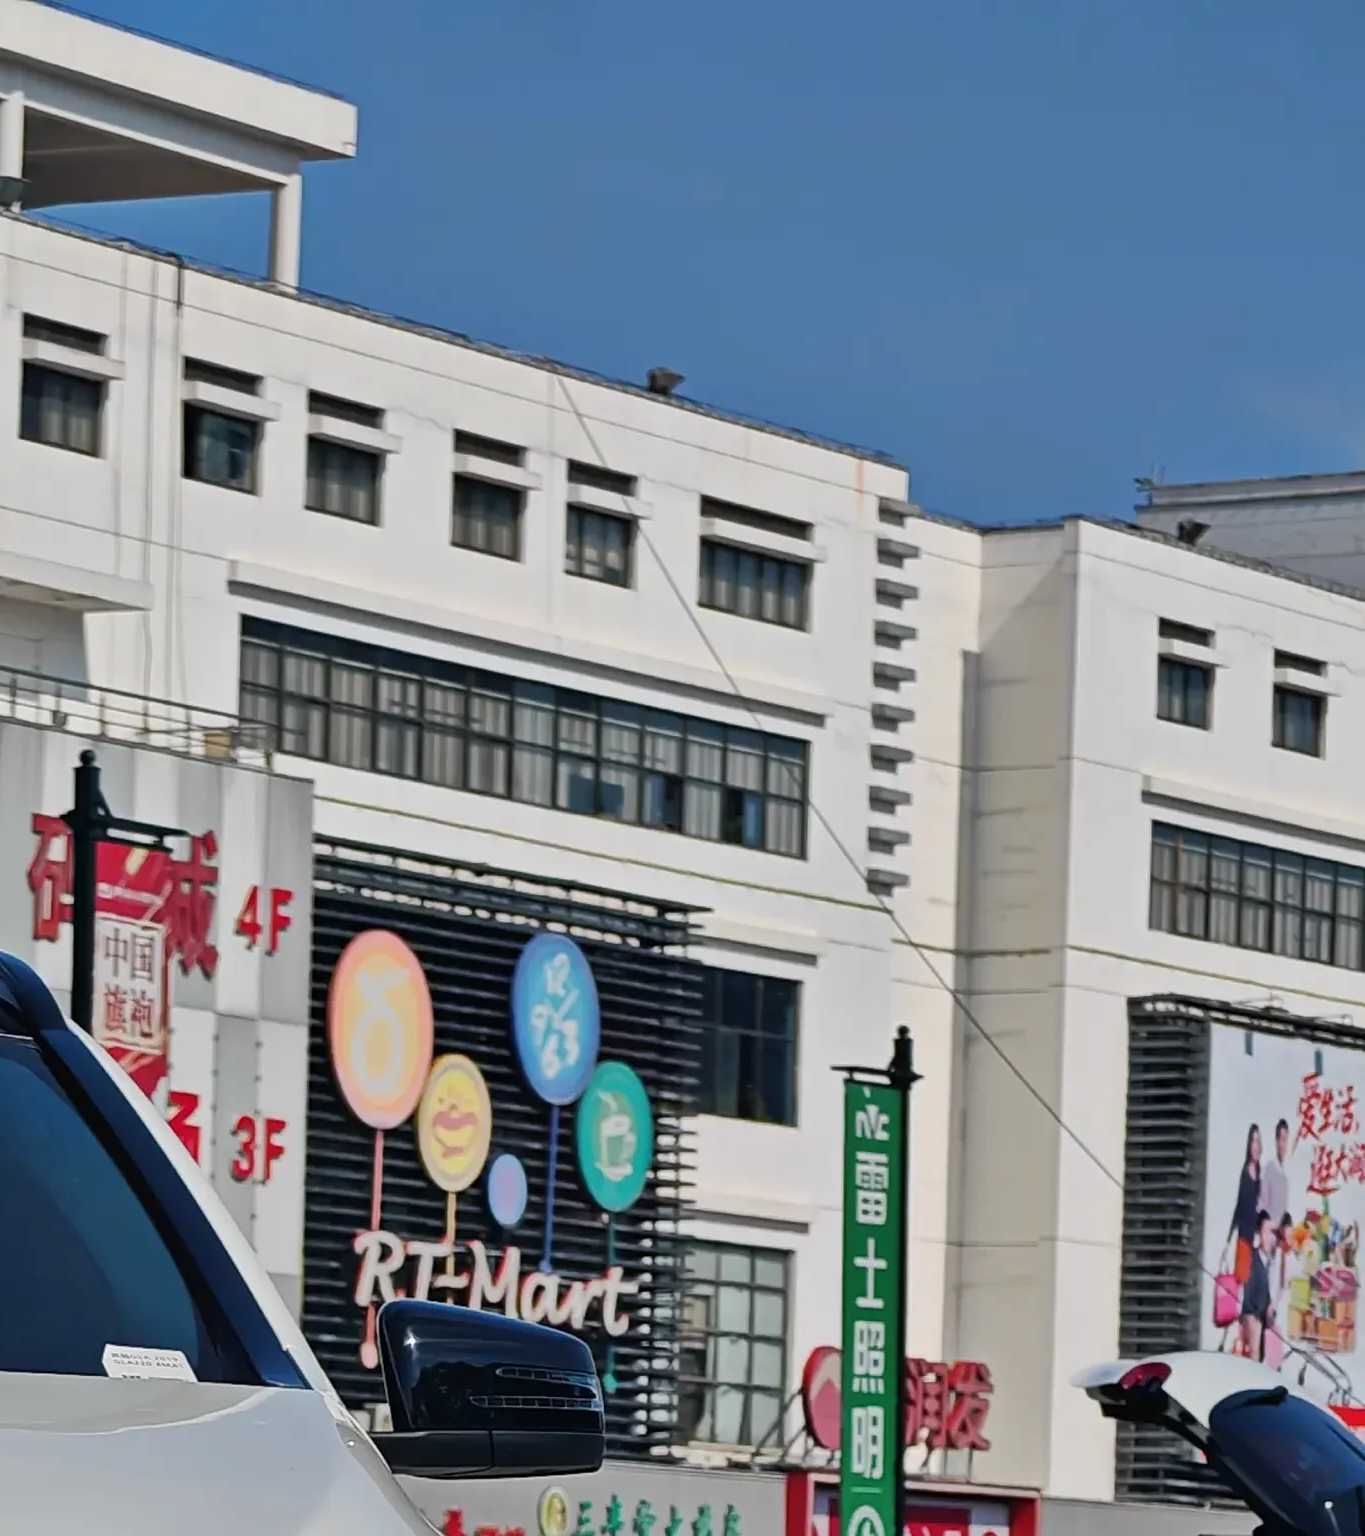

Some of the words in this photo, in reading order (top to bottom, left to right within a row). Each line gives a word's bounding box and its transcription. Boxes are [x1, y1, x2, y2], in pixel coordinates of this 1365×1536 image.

[105, 927, 156, 983] 中国
[235, 885, 294, 954] 4F
[230, 1115, 287, 1183] 3F
[353, 1230, 639, 1337] RT-Mart
[849, 1151, 890, 1480] 雷士照明
[905, 1357, 995, 1451] 润发
